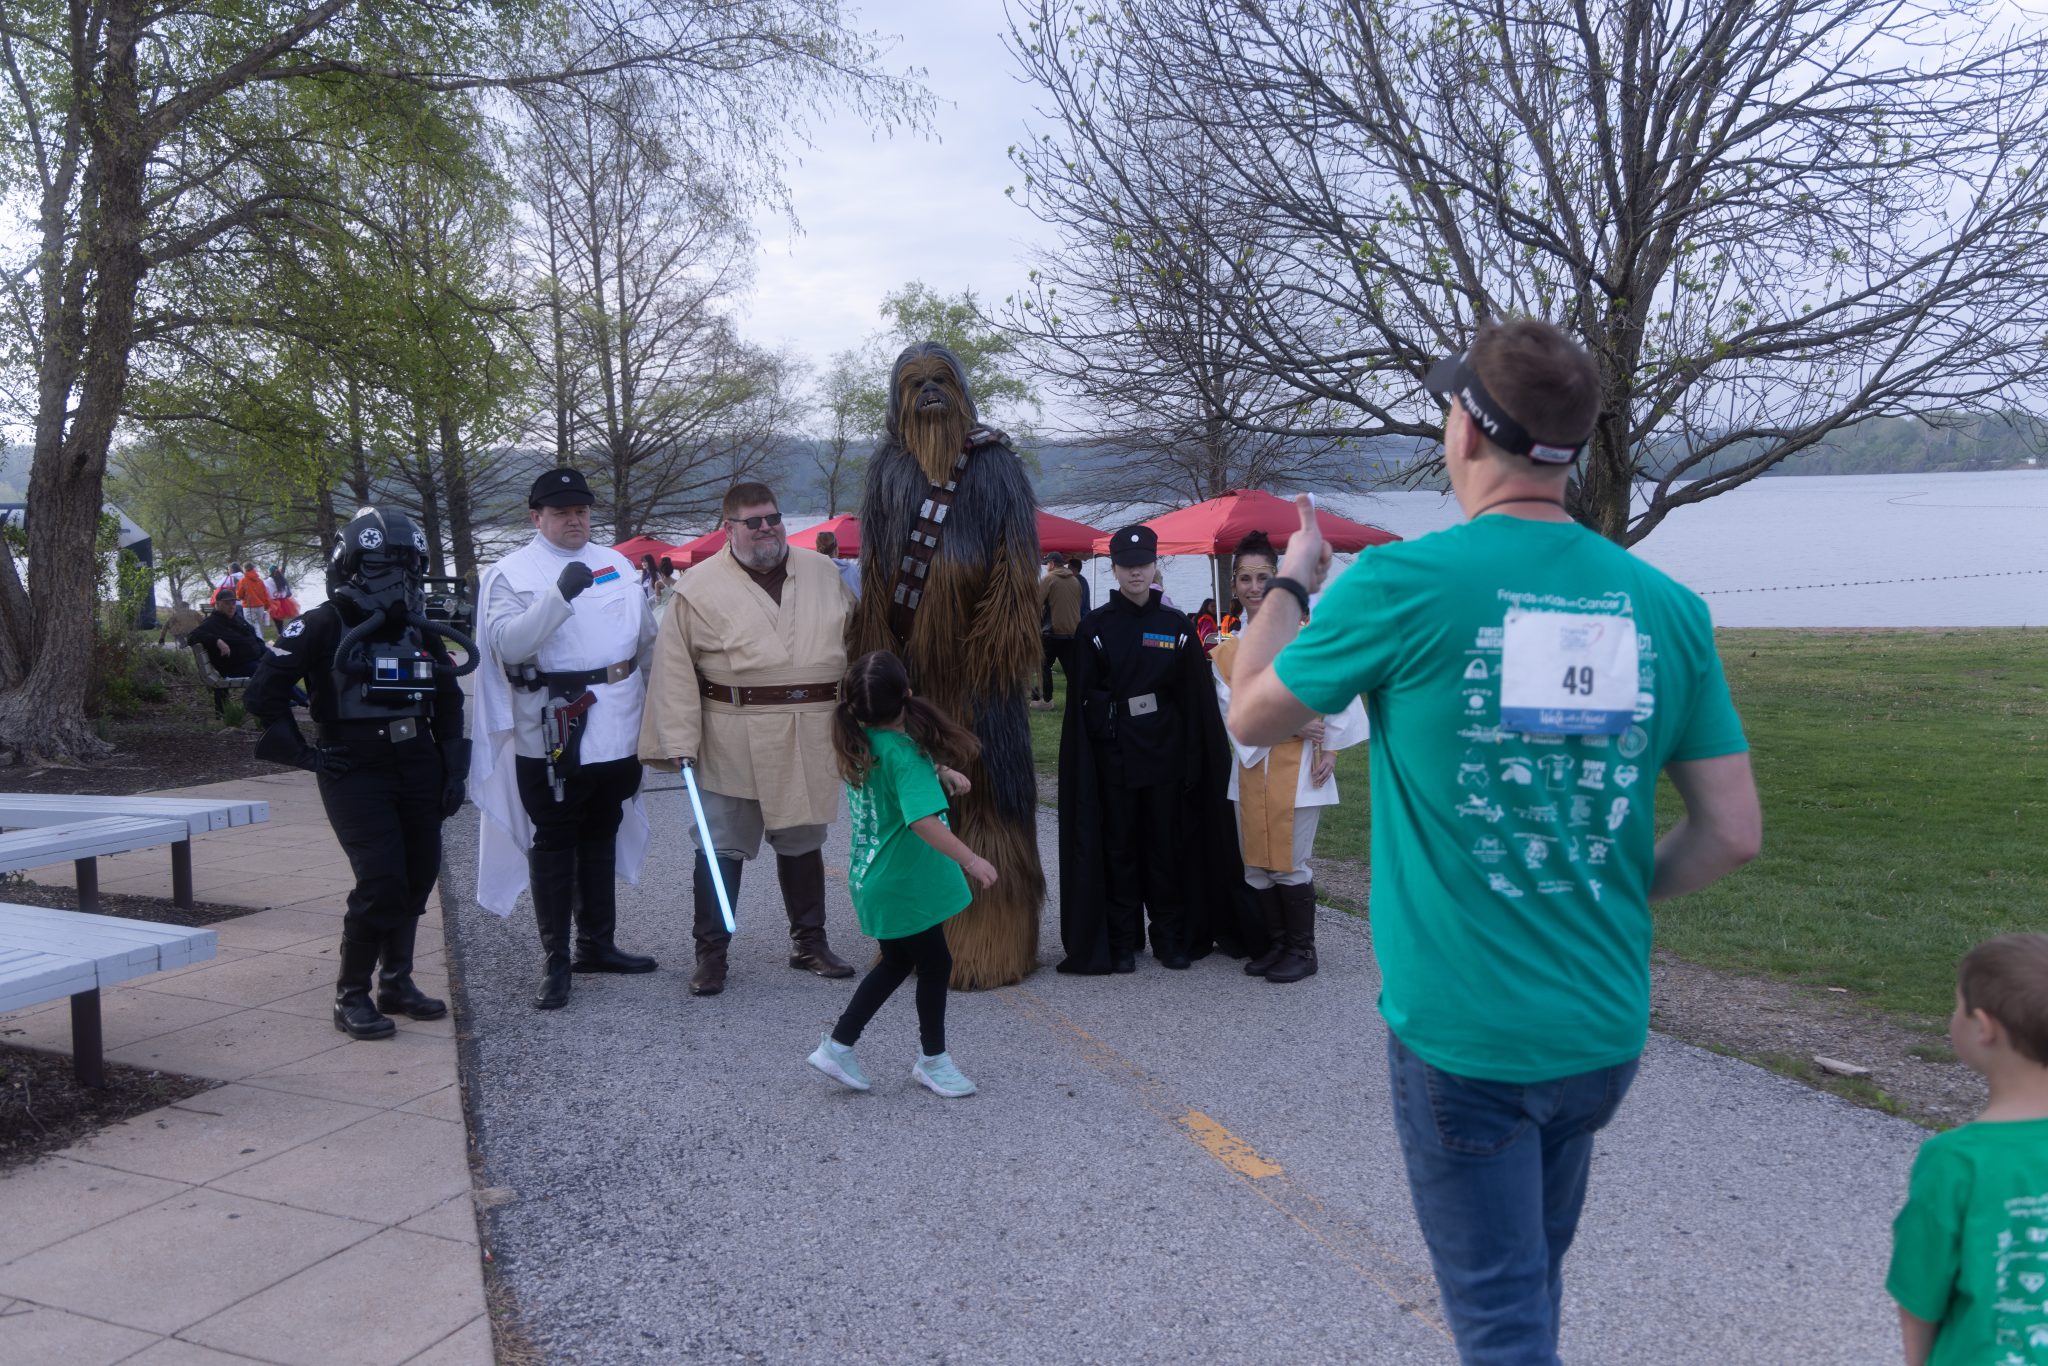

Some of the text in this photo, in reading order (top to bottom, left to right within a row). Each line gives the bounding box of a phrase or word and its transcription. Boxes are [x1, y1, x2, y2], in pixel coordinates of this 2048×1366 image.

[1497, 588, 1537, 604] Friends
[1544, 593, 1566, 607] Kids
[1577, 597, 1620, 610] Cancer
[1562, 666, 1594, 695] 49
